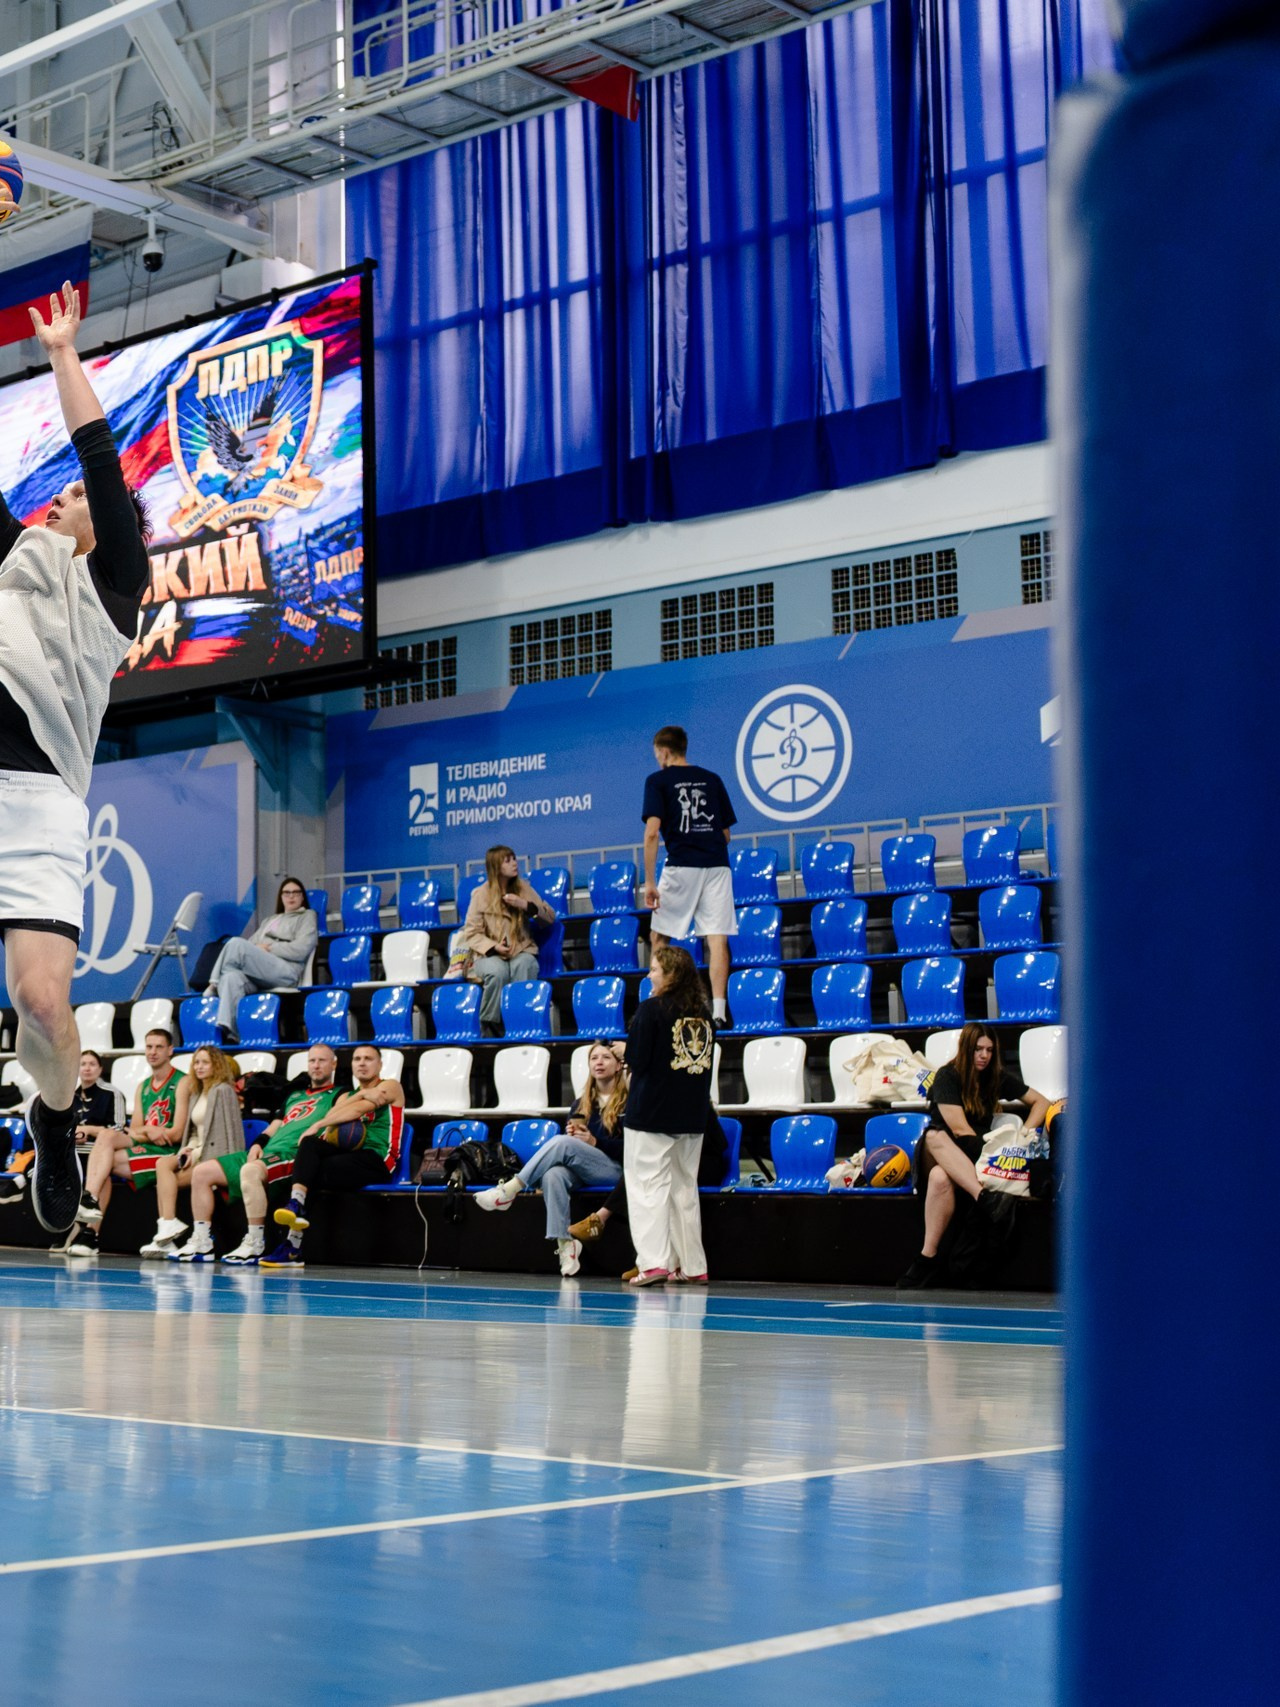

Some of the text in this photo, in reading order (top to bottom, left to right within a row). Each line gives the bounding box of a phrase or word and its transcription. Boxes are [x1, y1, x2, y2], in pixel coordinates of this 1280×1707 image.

[195, 338, 293, 401] ЛДПР
[314, 546, 364, 584] ЛДПР
[446, 752, 547, 782] ТЕЛЕВИДЕНИЕ
[446, 781, 507, 804] И РАДИО
[446, 793, 592, 827] ПРИМОРСКОГО КРАЯ
[409, 823, 439, 837] РЕГИОН
[993, 1155, 1027, 1171] ЛДПР
